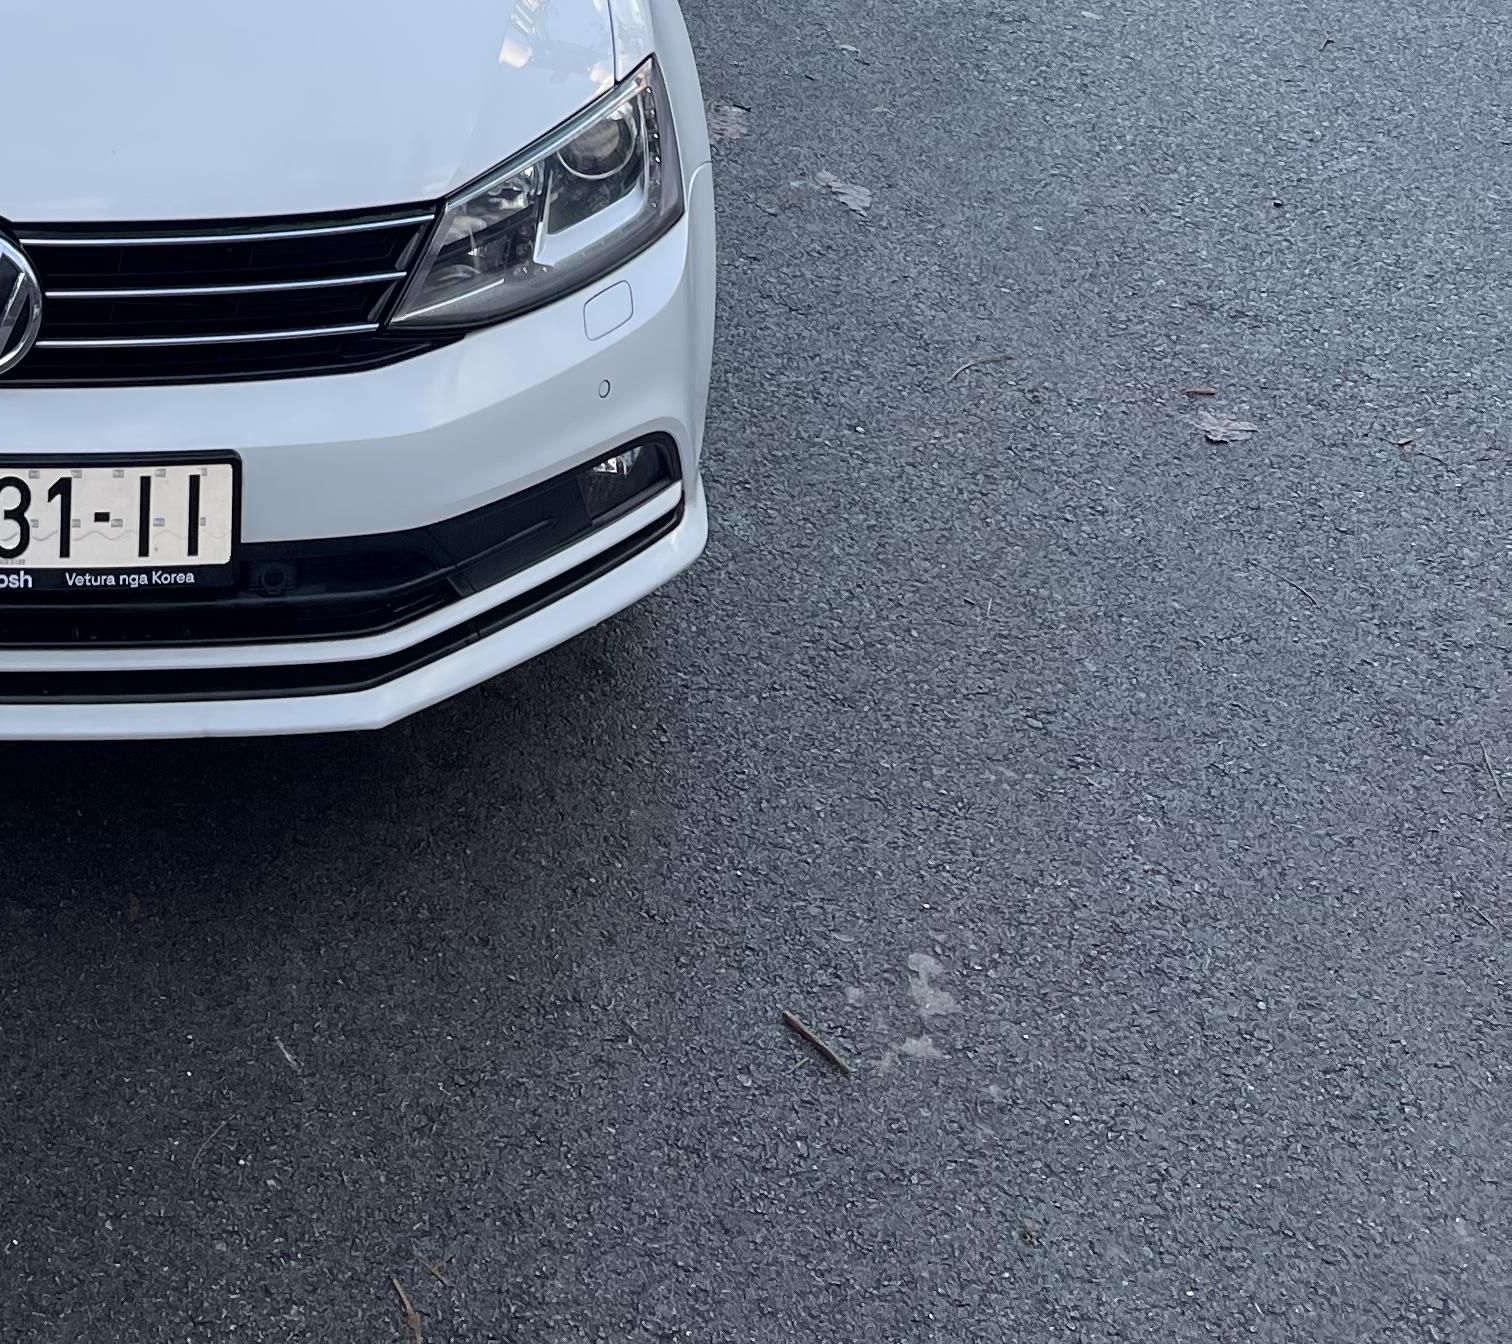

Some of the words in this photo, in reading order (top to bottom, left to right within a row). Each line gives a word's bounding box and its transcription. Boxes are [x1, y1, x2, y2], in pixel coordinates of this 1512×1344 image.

[65, 572, 116, 586] Vetura
[119, 575, 148, 588] nga
[151, 571, 195, 584] Korea
